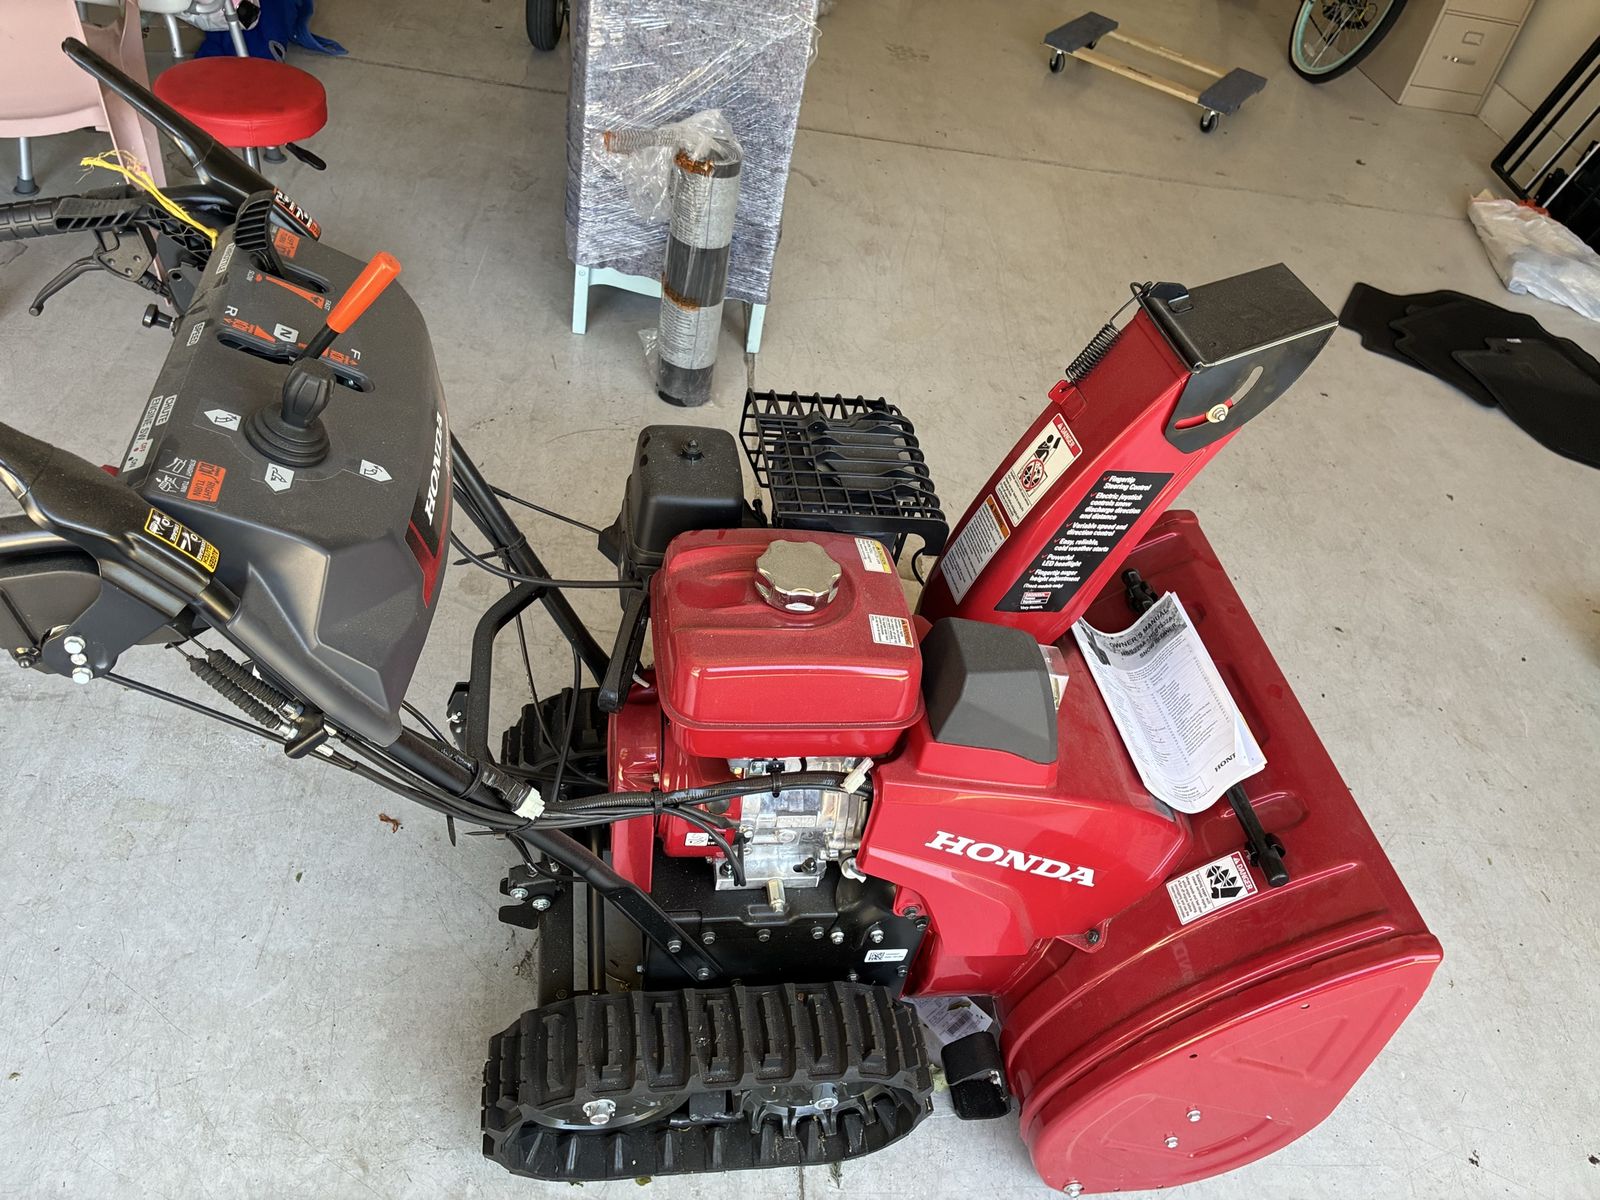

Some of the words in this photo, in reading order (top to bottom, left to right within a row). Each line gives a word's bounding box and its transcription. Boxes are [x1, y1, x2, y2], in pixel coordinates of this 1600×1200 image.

[224, 305, 238, 317] R
[280, 328, 293, 339] N
[350, 348, 361, 360] F
[142, 399, 160, 428] ENGINE
[158, 397, 176, 424] CHUTE
[1060, 428, 1076, 449] DANGER
[425, 411, 443, 526] HONDA
[193, 480, 205, 496] TURN
[1103, 483, 1129, 491] Steering
[1109, 475, 1136, 484] Fingertip
[204, 480, 216, 501] RIGHT
[1085, 506, 1114, 514] discharge
[1059, 538, 1075, 547] Easy,
[208, 548, 219, 568] AUGER
[1110, 632, 1143, 648] OWNER'S
[1142, 608, 1168, 634] MANUAL
[925, 830, 1095, 888] HONDA
[1237, 863, 1254, 890] DANGER
